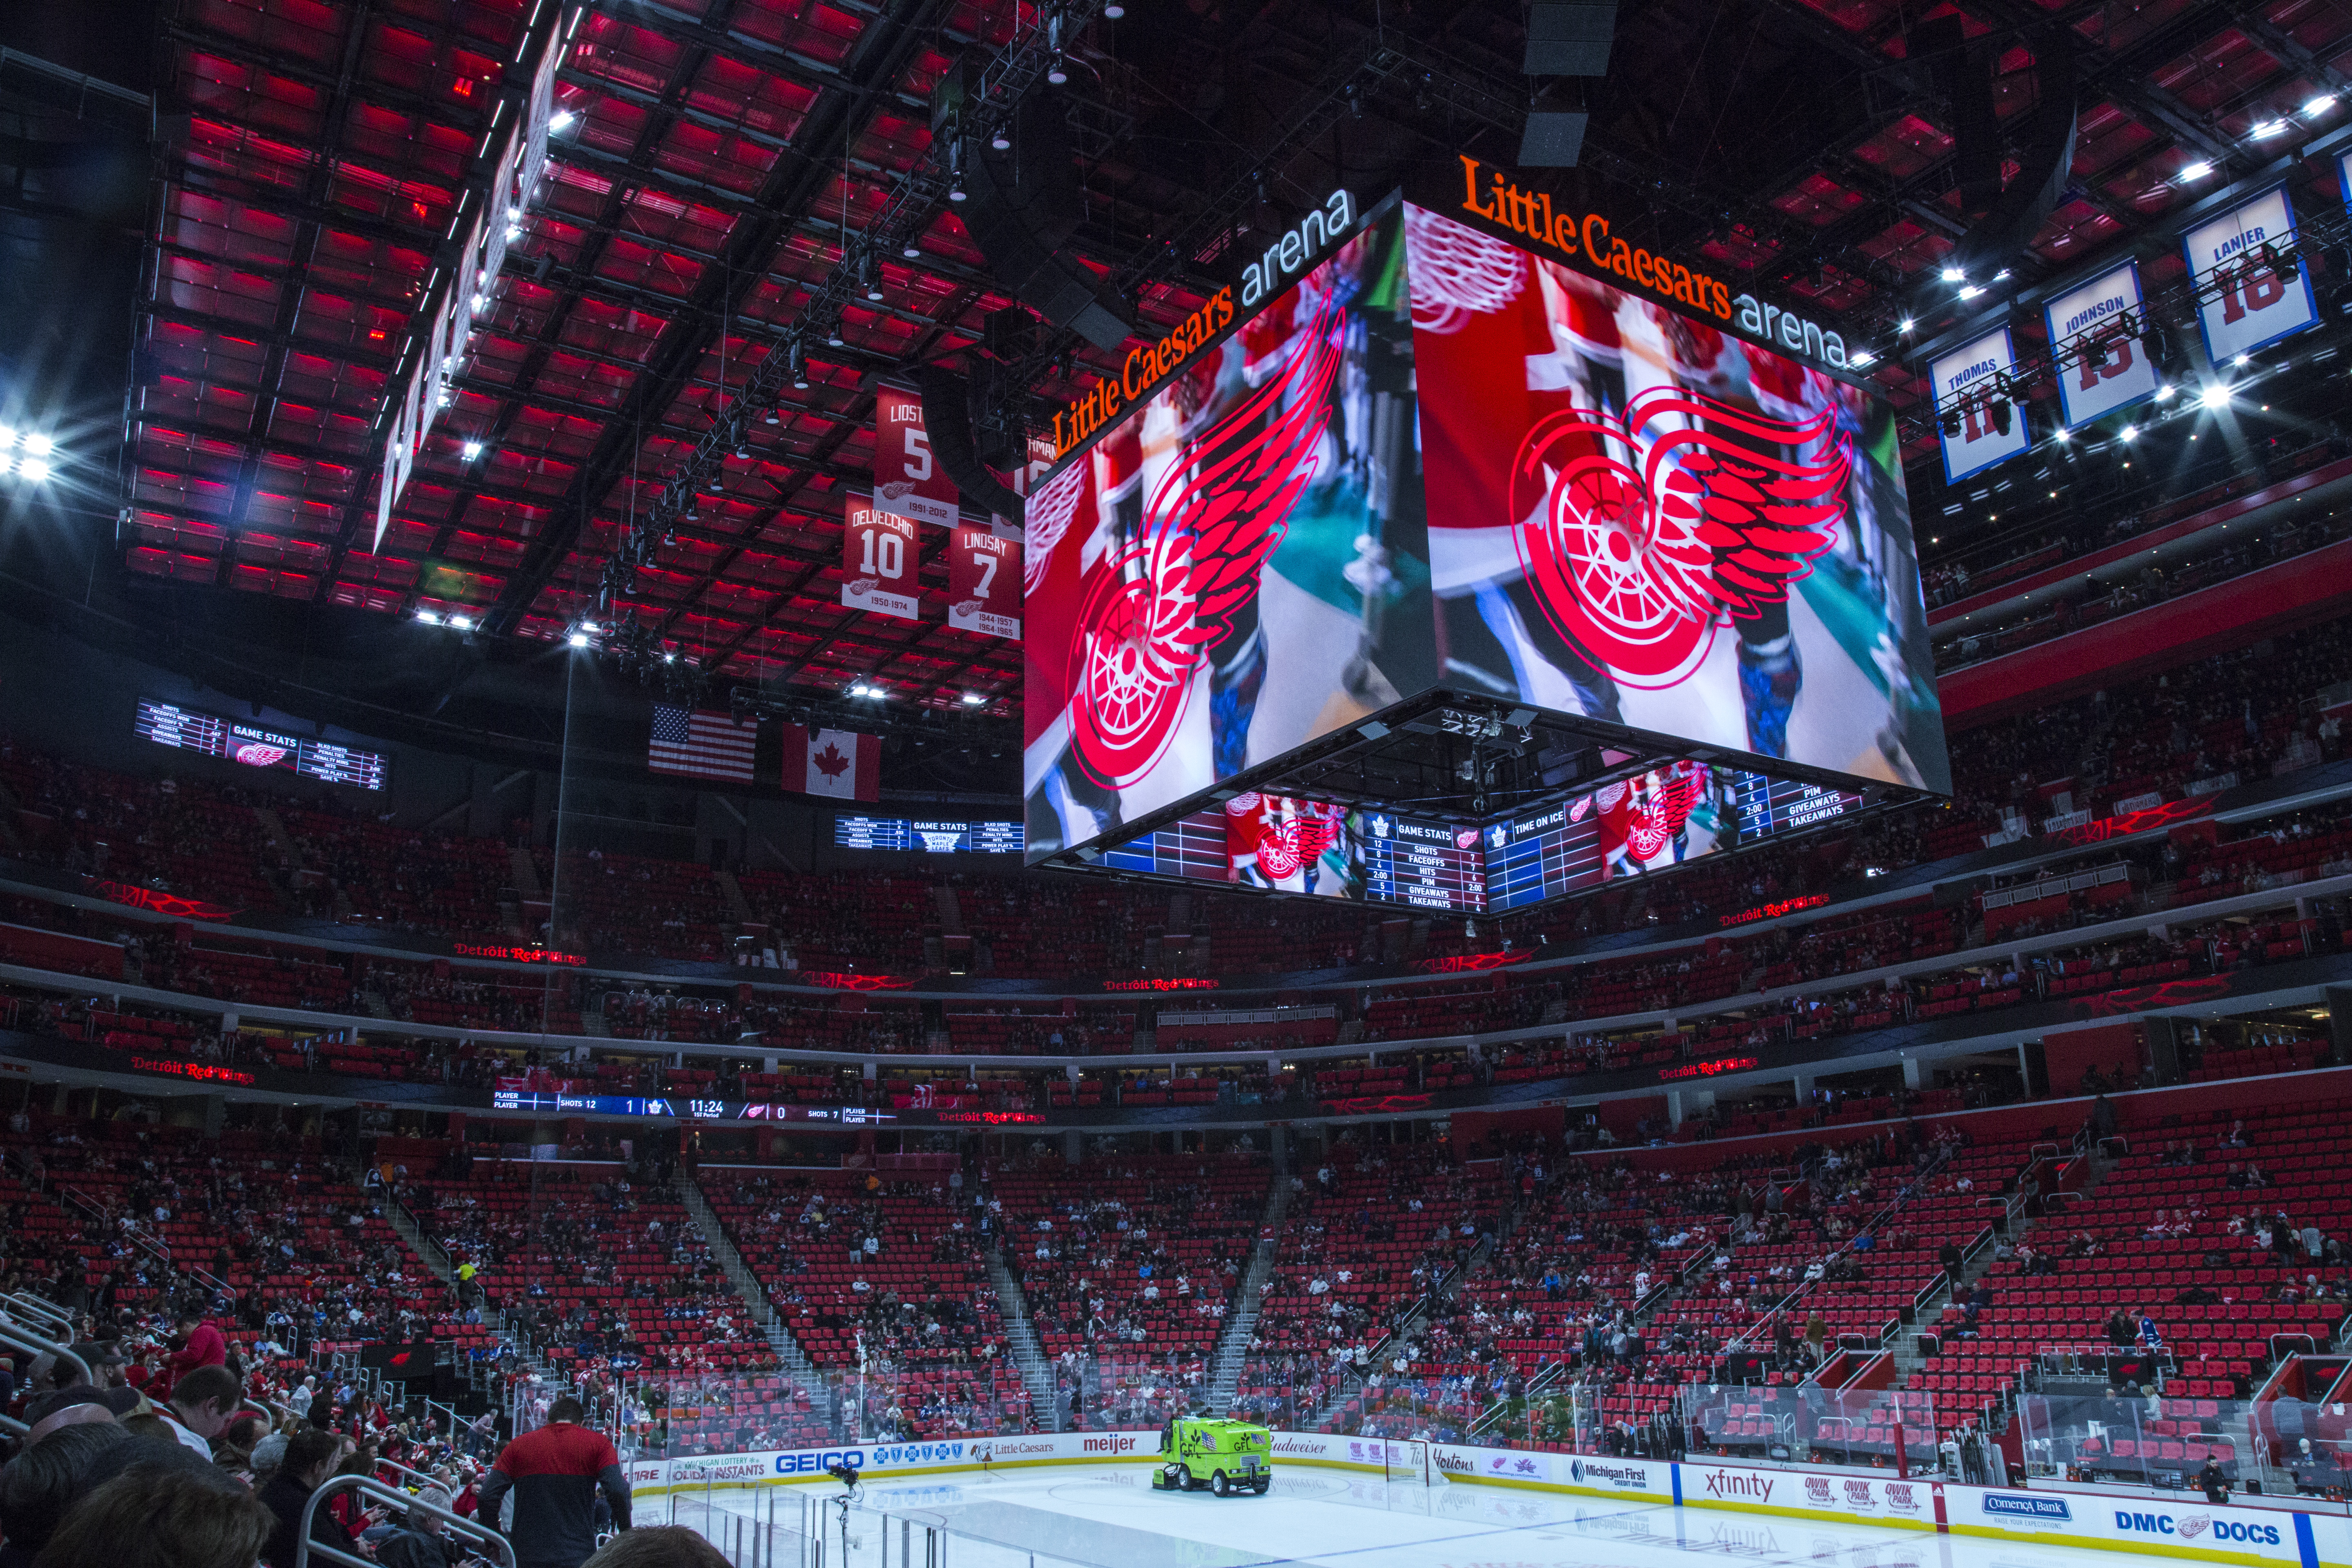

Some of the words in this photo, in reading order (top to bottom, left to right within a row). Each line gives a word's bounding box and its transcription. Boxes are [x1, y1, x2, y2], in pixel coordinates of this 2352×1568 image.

[2214, 227, 2266, 263] LANIER
[1459, 154, 1577, 254] Little
[1582, 213, 1731, 319] Caesars
[1736, 293, 1848, 369] arena
[2066, 295, 2125, 335] JOHNSON
[1053, 379, 1120, 461] Little
[1123, 285, 1235, 401] Caesars
[1241, 188, 1355, 307] arena
[1948, 358, 1997, 391] THOMAS
[904, 427, 932, 481] 5
[909, 502, 947, 519] 1991-2012
[853, 509, 913, 540] DELVECCHIO
[964, 532, 1007, 557] LINDSAY
[860, 528, 904, 580] 10
[973, 553, 997, 599] 7
[871, 596, 908, 611] 1950-1974
[978, 613, 1013, 627] 1944-1957
[978, 623, 1013, 637] 1964-1965
[149, 707, 176, 720] FACEOFFS
[162, 704, 180, 713] SHOTS
[154, 715, 176, 726] FACEOFF
[152, 729, 182, 740] GIVEAWAYS
[157, 723, 178, 733] ASSISTS
[151, 736, 181, 747] TAKEAWAYS
[234, 725, 263, 739] GAME
[265, 733, 297, 747] STATS
[314, 754, 334, 763] PENALTY
[318, 749, 345, 759] PENALTIES
[312, 766, 328, 775] POWER
[1748, 782, 1754, 790] 8
[1804, 786, 1821, 798] PIM
[1750, 793, 1755, 802] 4
[1789, 793, 1840, 815] GIVEAWAYS
[1746, 804, 1762, 815] 2:00
[1788, 804, 1843, 827] TAKEAWAYS
[1515, 820, 1535, 834] TIME
[1536, 816, 1548, 827] ON
[1550, 811, 1564, 823] ICE
[1755, 816, 1760, 824] 5
[1399, 825, 1423, 837] GAME
[1425, 829, 1451, 840] STATS
[1756, 829, 1762, 837] 2
[1414, 846, 1437, 855] SHOTS
[1409, 855, 1445, 867] FACEOFFS
[1374, 871, 1388, 880] 2:00
[1419, 867, 1436, 876] HITS
[1422, 878, 1435, 886] PIM
[1469, 884, 1482, 892] 2:00
[1409, 886, 1449, 898] GIVEAWAYS
[1408, 896, 1450, 908] TAKEAWAYS
[1719, 908, 1762, 926] Detroit
[1763, 900, 1790, 917] Red
[1789, 893, 1829, 909] Wings
[454, 943, 508, 958] Detroit
[510, 948, 540, 962] Red
[541, 951, 587, 966] Wings
[1103, 980, 1150, 990] Detroit
[1152, 979, 1178, 991] Red
[1178, 978, 1219, 990] Wings
[131, 1056, 183, 1074] Detroit
[185, 1063, 213, 1080] Red
[214, 1067, 255, 1085] Wings
[1659, 1065, 1697, 1079] Detroit
[1698, 1060, 1722, 1075] Red
[1721, 1057, 1758, 1069] Wings
[586, 1100, 596, 1109] 12
[627, 1100, 632, 1113] 1
[690, 1099, 723, 1113] 11:24
[777, 1107, 785, 1119] 0
[937, 1112, 981, 1122] Detroit
[982, 1112, 1007, 1124] Red
[1007, 1112, 1046, 1124] Wings
[995, 1442, 1017, 1455] Little
[1018, 1441, 1054, 1453] Caesars
[1083, 1434, 1136, 1454] meijer
[1234, 1440, 1251, 1451] GFL
[722, 1457, 748, 1465] LOTTERY
[776, 1450, 864, 1473] GEICO
[1433, 1447, 1473, 1471] Hortons
[634, 1469, 660, 1481] TIRE
[715, 1464, 764, 1480] INSTANTS
[1586, 1464, 1624, 1480] Michigan
[1625, 1468, 1646, 1481] First
[1705, 1469, 1774, 1503] xfinity
[1805, 1477, 1830, 1490] QWIK
[1844, 1480, 1870, 1492] QWIK
[1885, 1483, 1913, 1496] QWIK
[1811, 1489, 1830, 1497] PARK
[1851, 1492, 1870, 1501] PARK
[1892, 1495, 1913, 1504] PARK
[2036, 1501, 2062, 1513] Bank
[2116, 1511, 2174, 1534] DMC
[2213, 1520, 2280, 1545] DOCS
